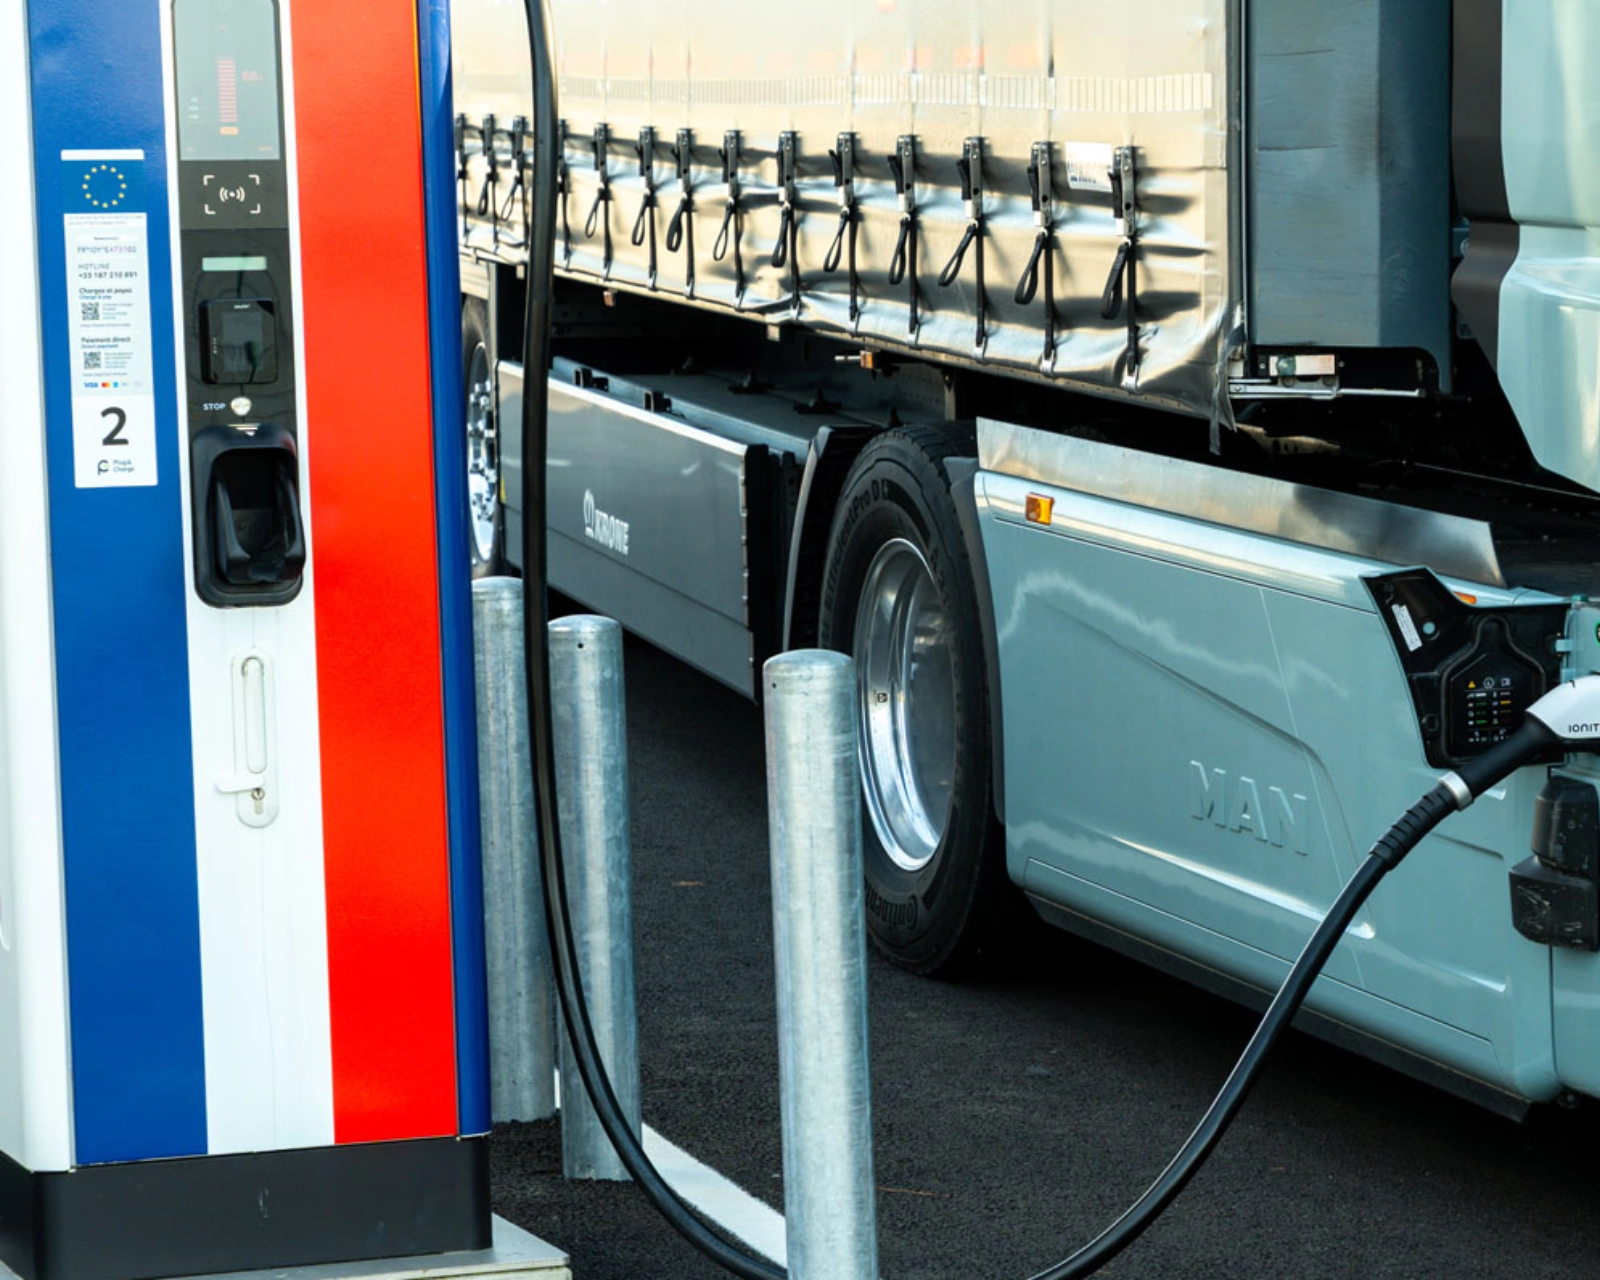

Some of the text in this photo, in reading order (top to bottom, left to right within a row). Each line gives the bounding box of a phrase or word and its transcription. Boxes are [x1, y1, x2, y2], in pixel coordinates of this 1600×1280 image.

[100, 406, 129, 446] 2
[203, 403, 227, 411] STOP
[594, 508, 629, 555] KRONE
[1190, 760, 1308, 857] MAN
